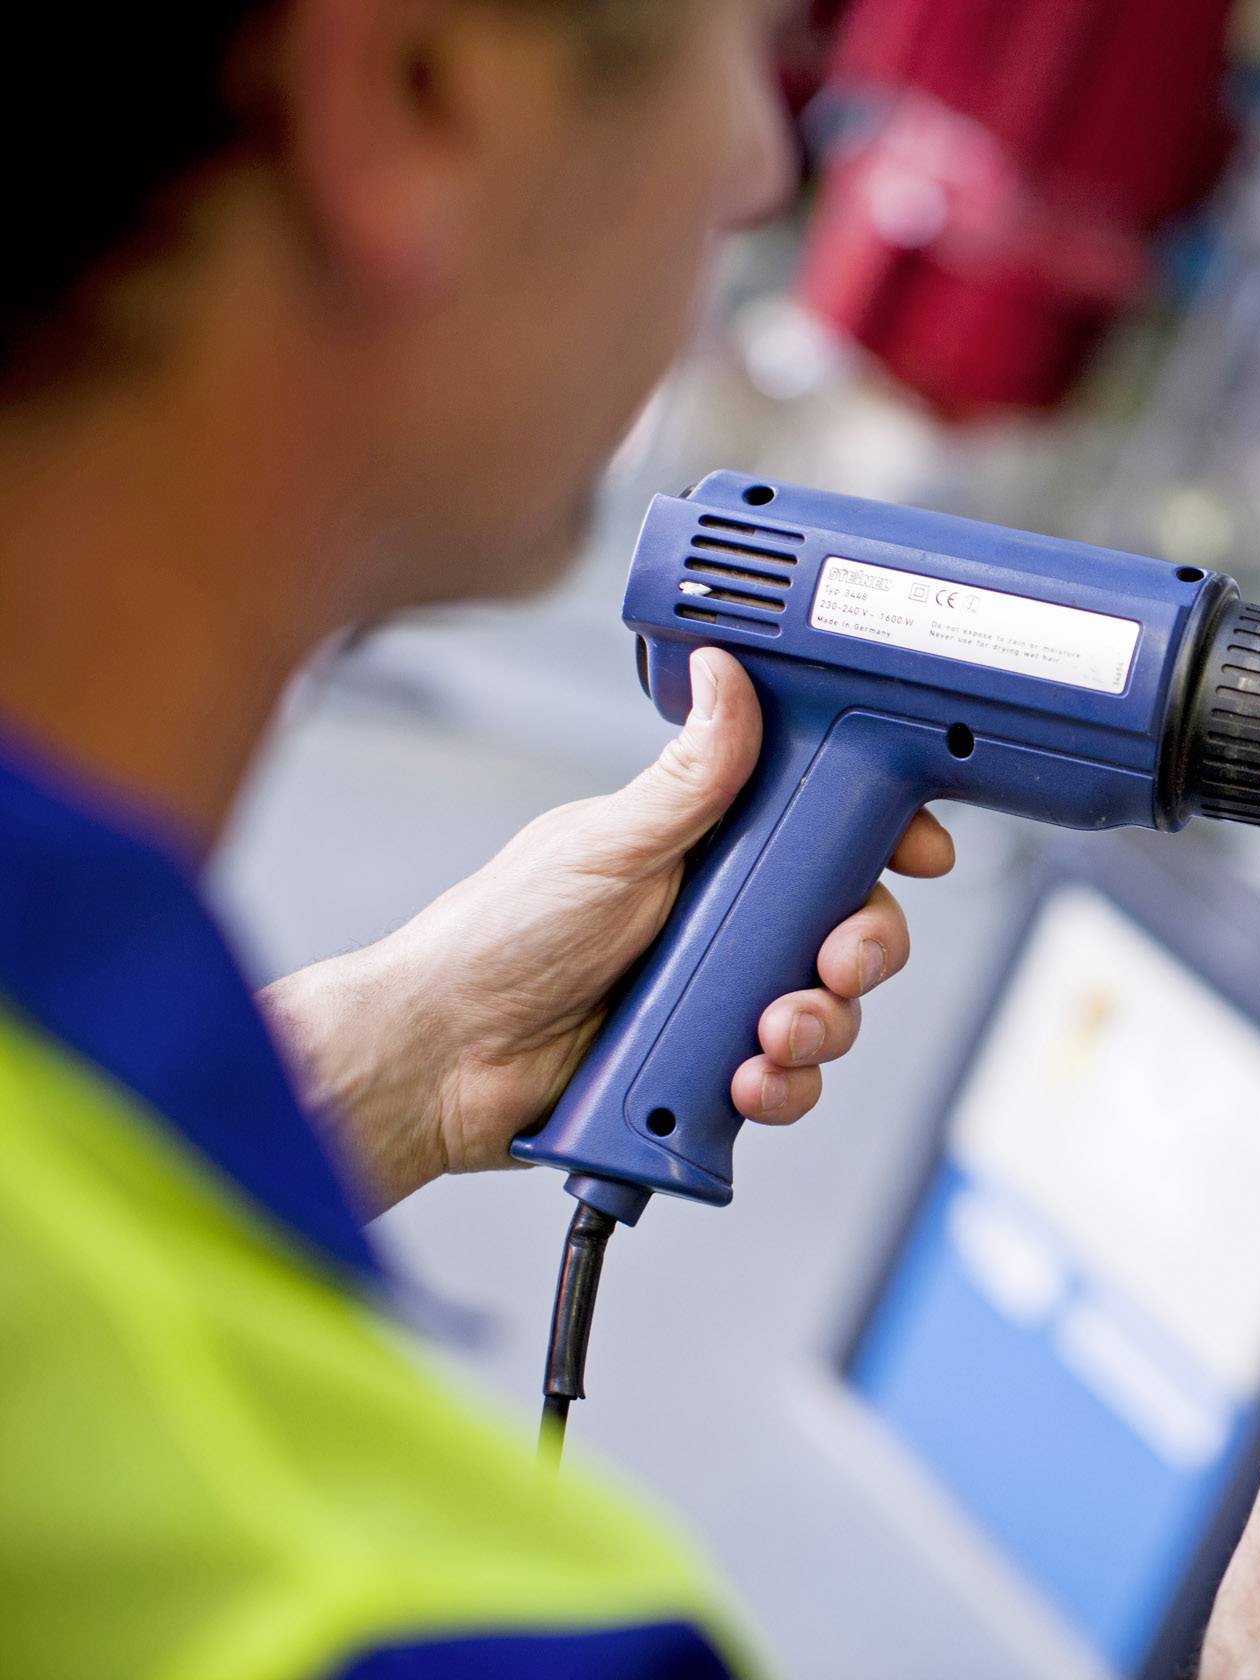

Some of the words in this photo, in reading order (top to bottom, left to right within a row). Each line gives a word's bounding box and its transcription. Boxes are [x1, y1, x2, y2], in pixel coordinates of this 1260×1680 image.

[816, 615, 838, 626] Made
[854, 623, 891, 637] Germany
[962, 628, 992, 640] expose
[929, 629, 954, 641] Never
[992, 643, 1020, 657] drying
